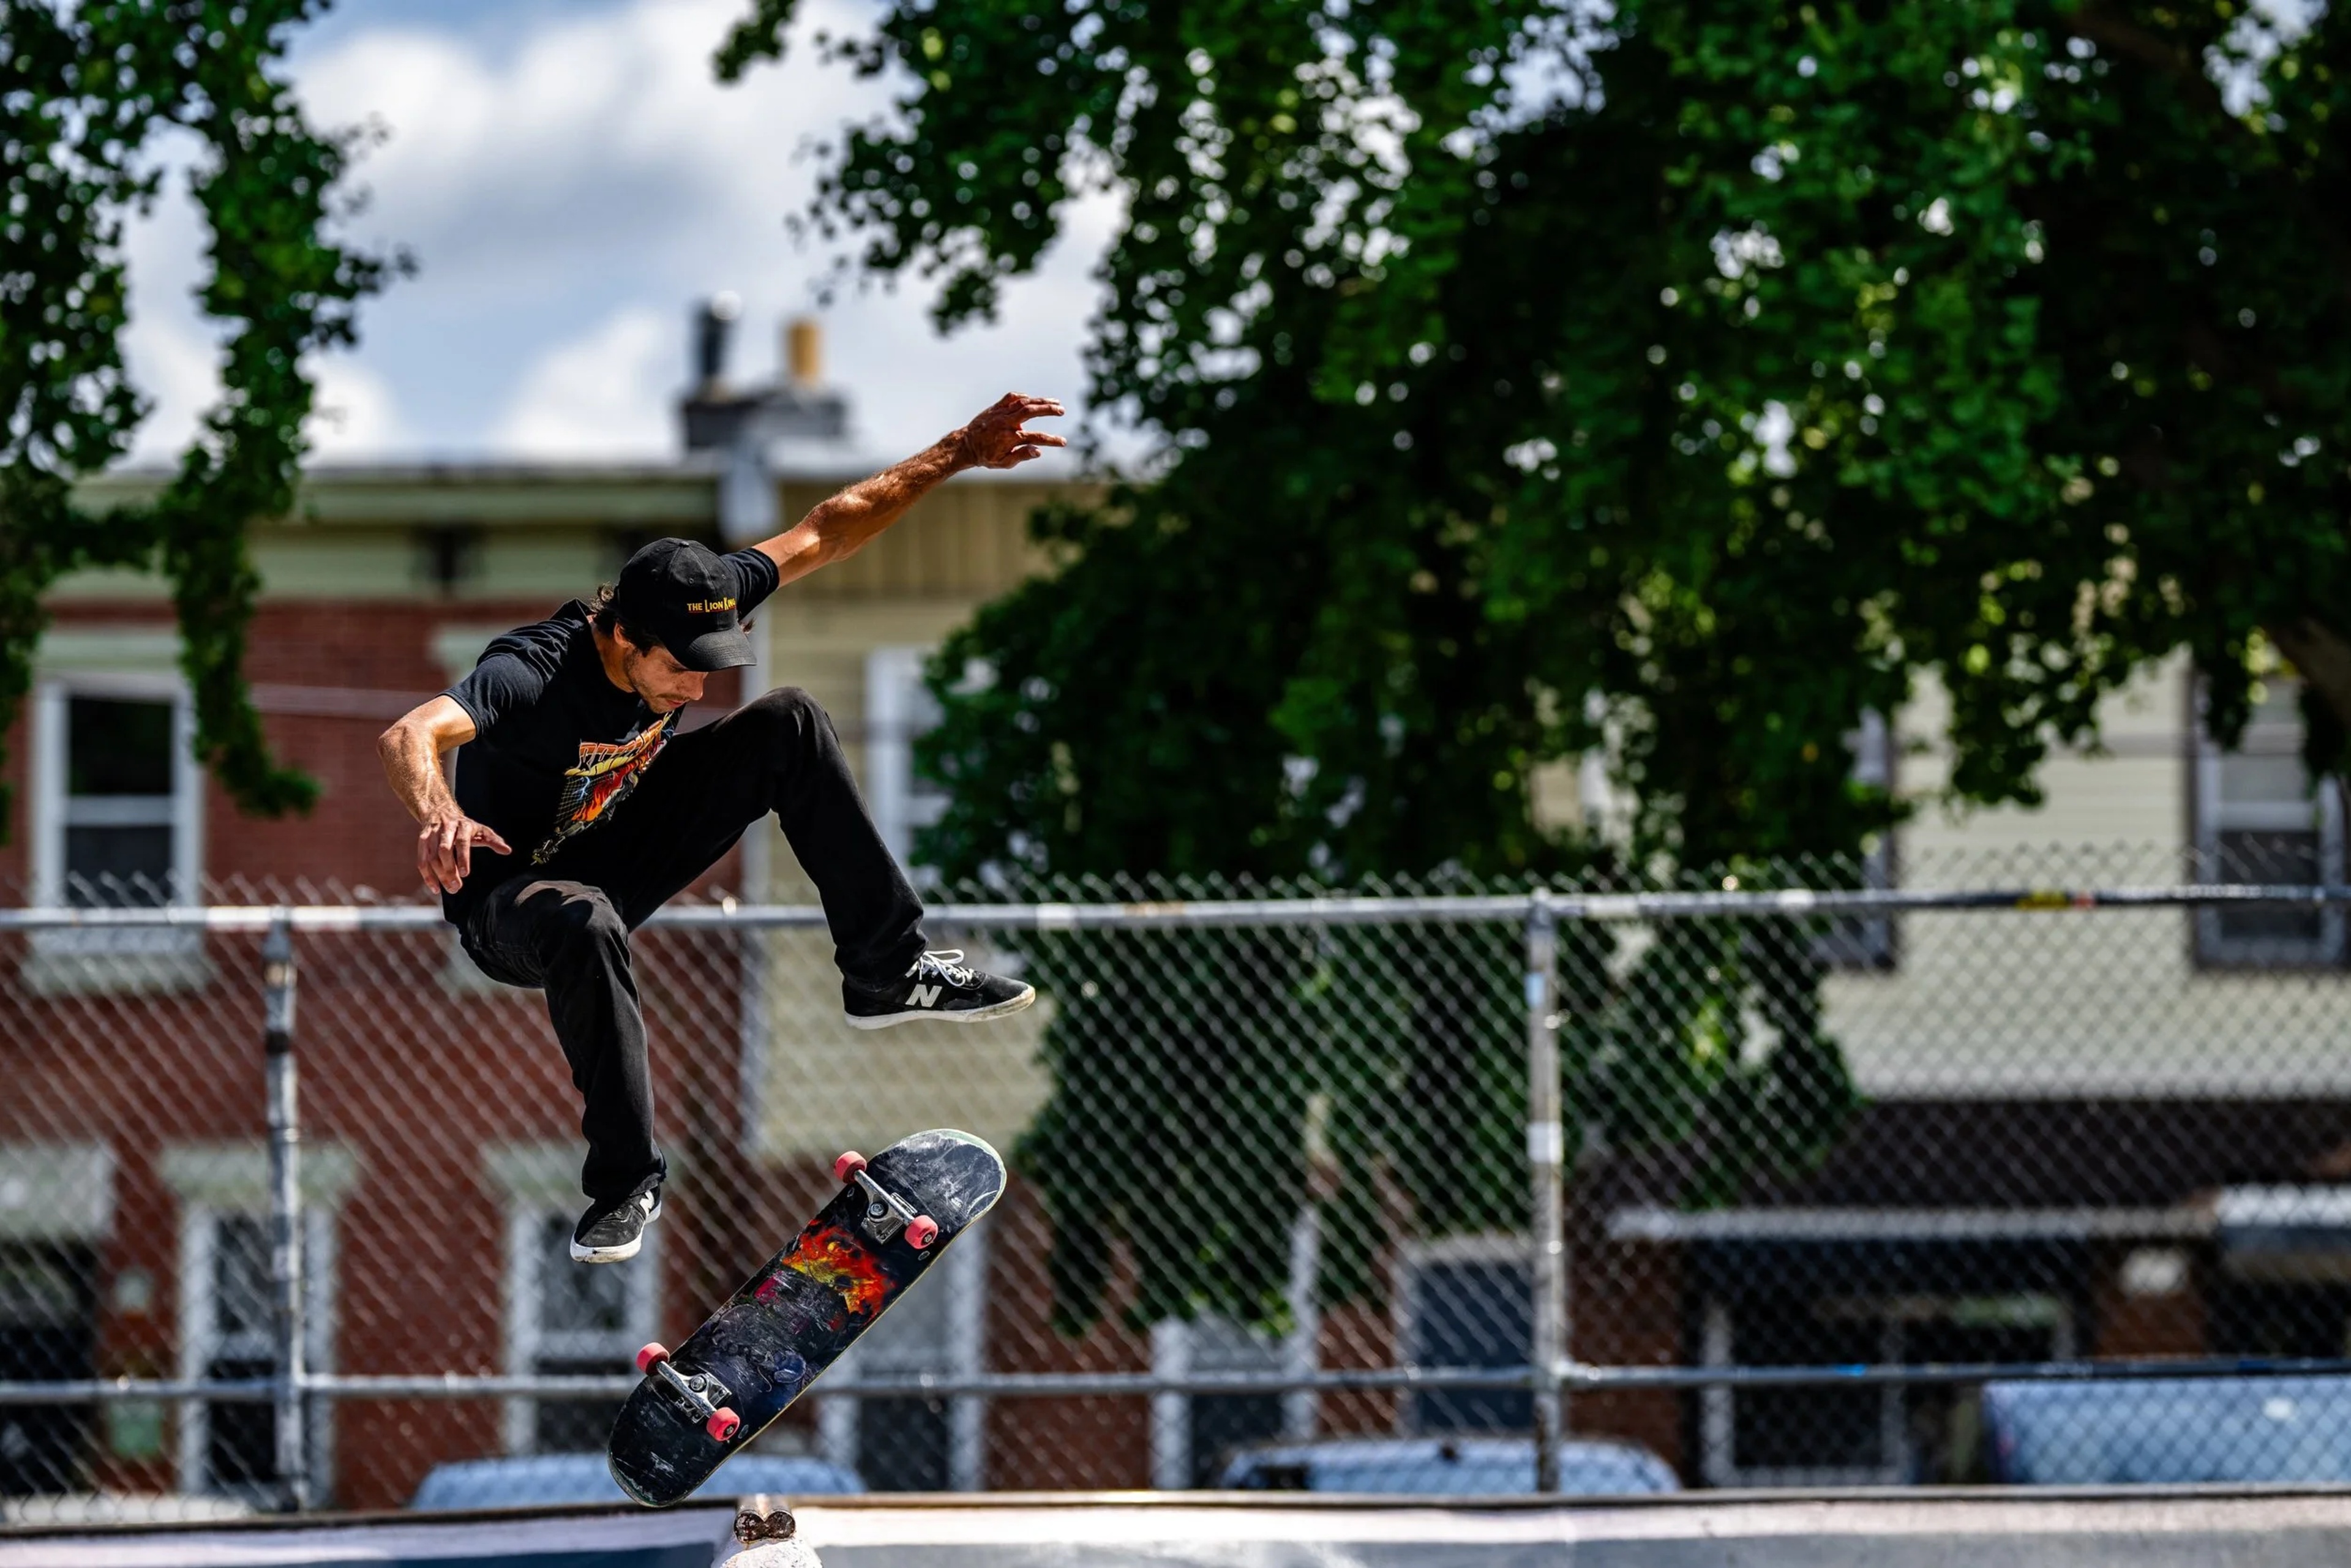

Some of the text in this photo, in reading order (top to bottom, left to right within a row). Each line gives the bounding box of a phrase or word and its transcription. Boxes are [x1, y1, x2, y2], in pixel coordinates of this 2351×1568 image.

[687, 602, 703, 611] THE
[704, 599, 724, 612] LION
[905, 984, 943, 1008] N
